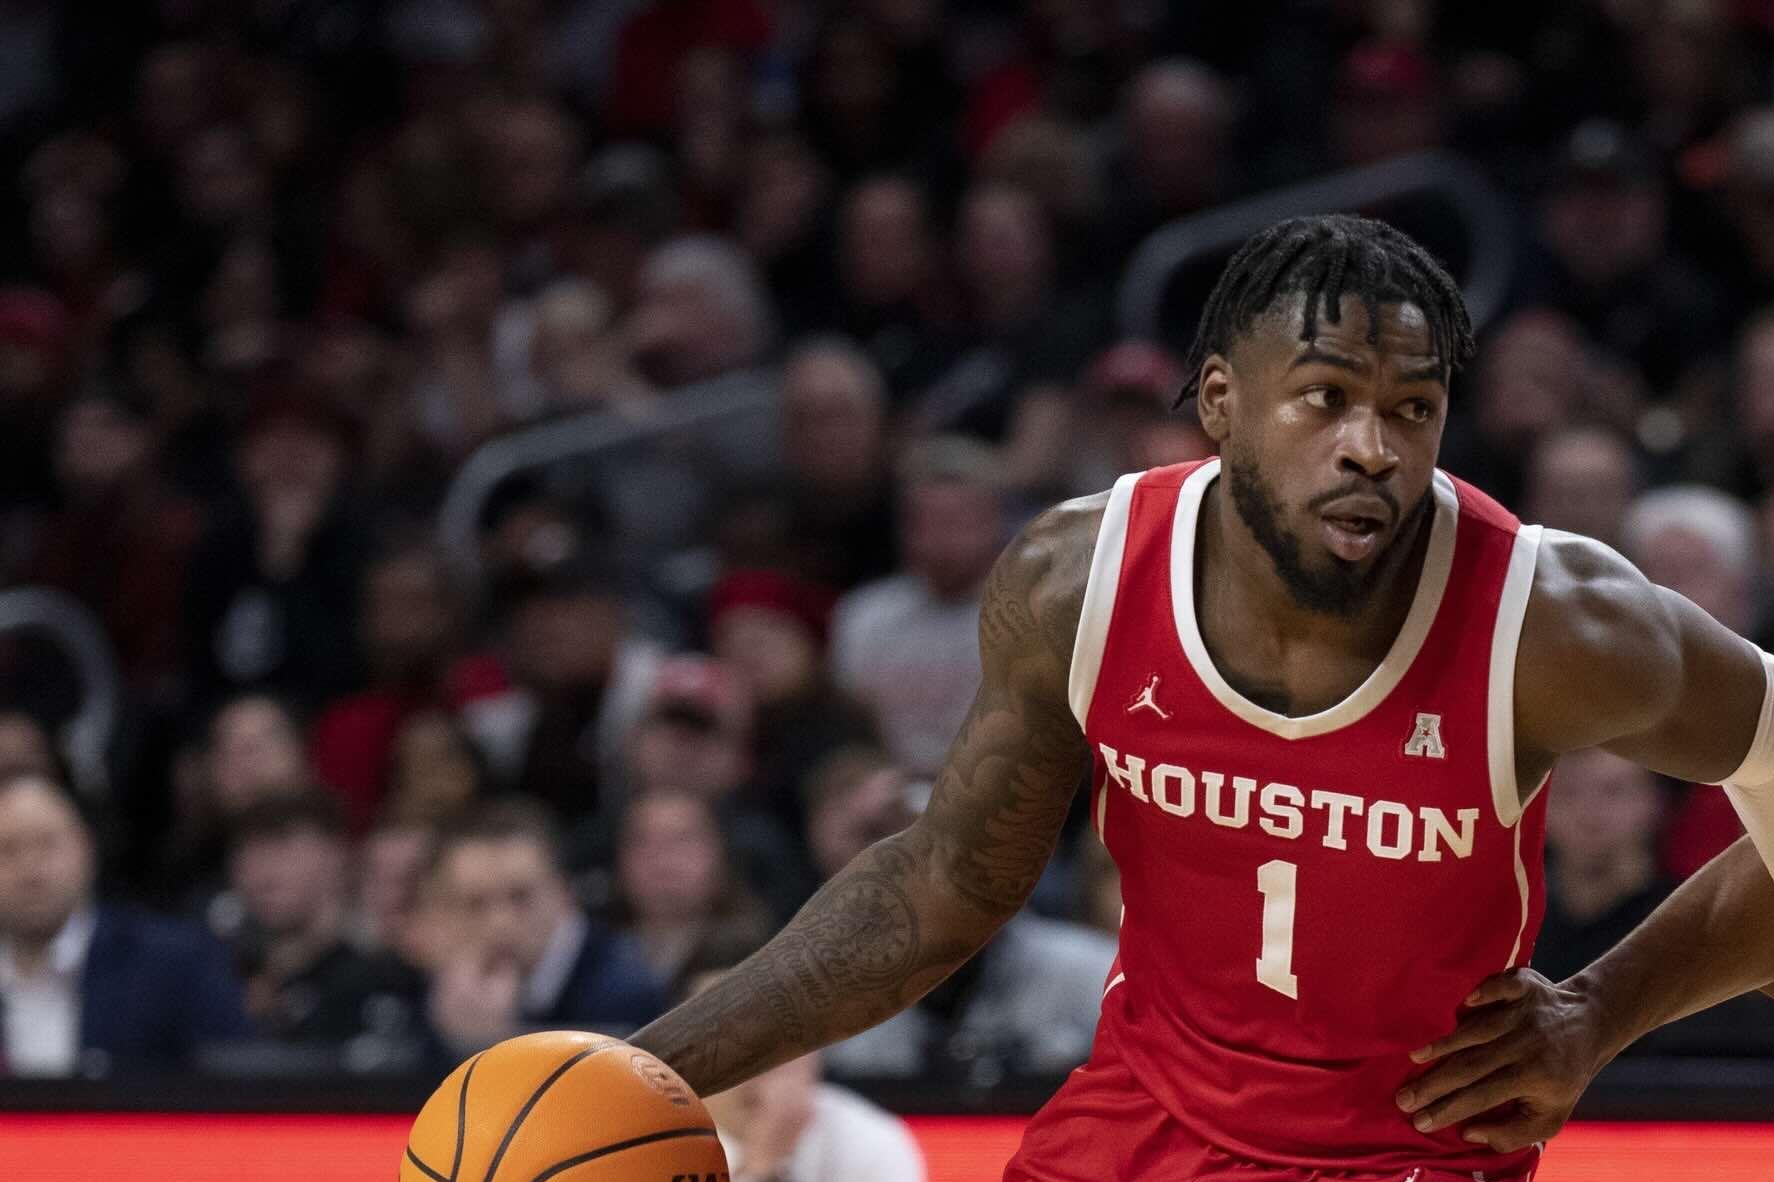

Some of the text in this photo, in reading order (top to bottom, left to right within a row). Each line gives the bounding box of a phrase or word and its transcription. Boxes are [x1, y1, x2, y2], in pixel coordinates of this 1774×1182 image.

[1404, 712, 1445, 759] A
[1099, 742, 1480, 862] HOUSTON
[1256, 859, 1298, 1000] 1
